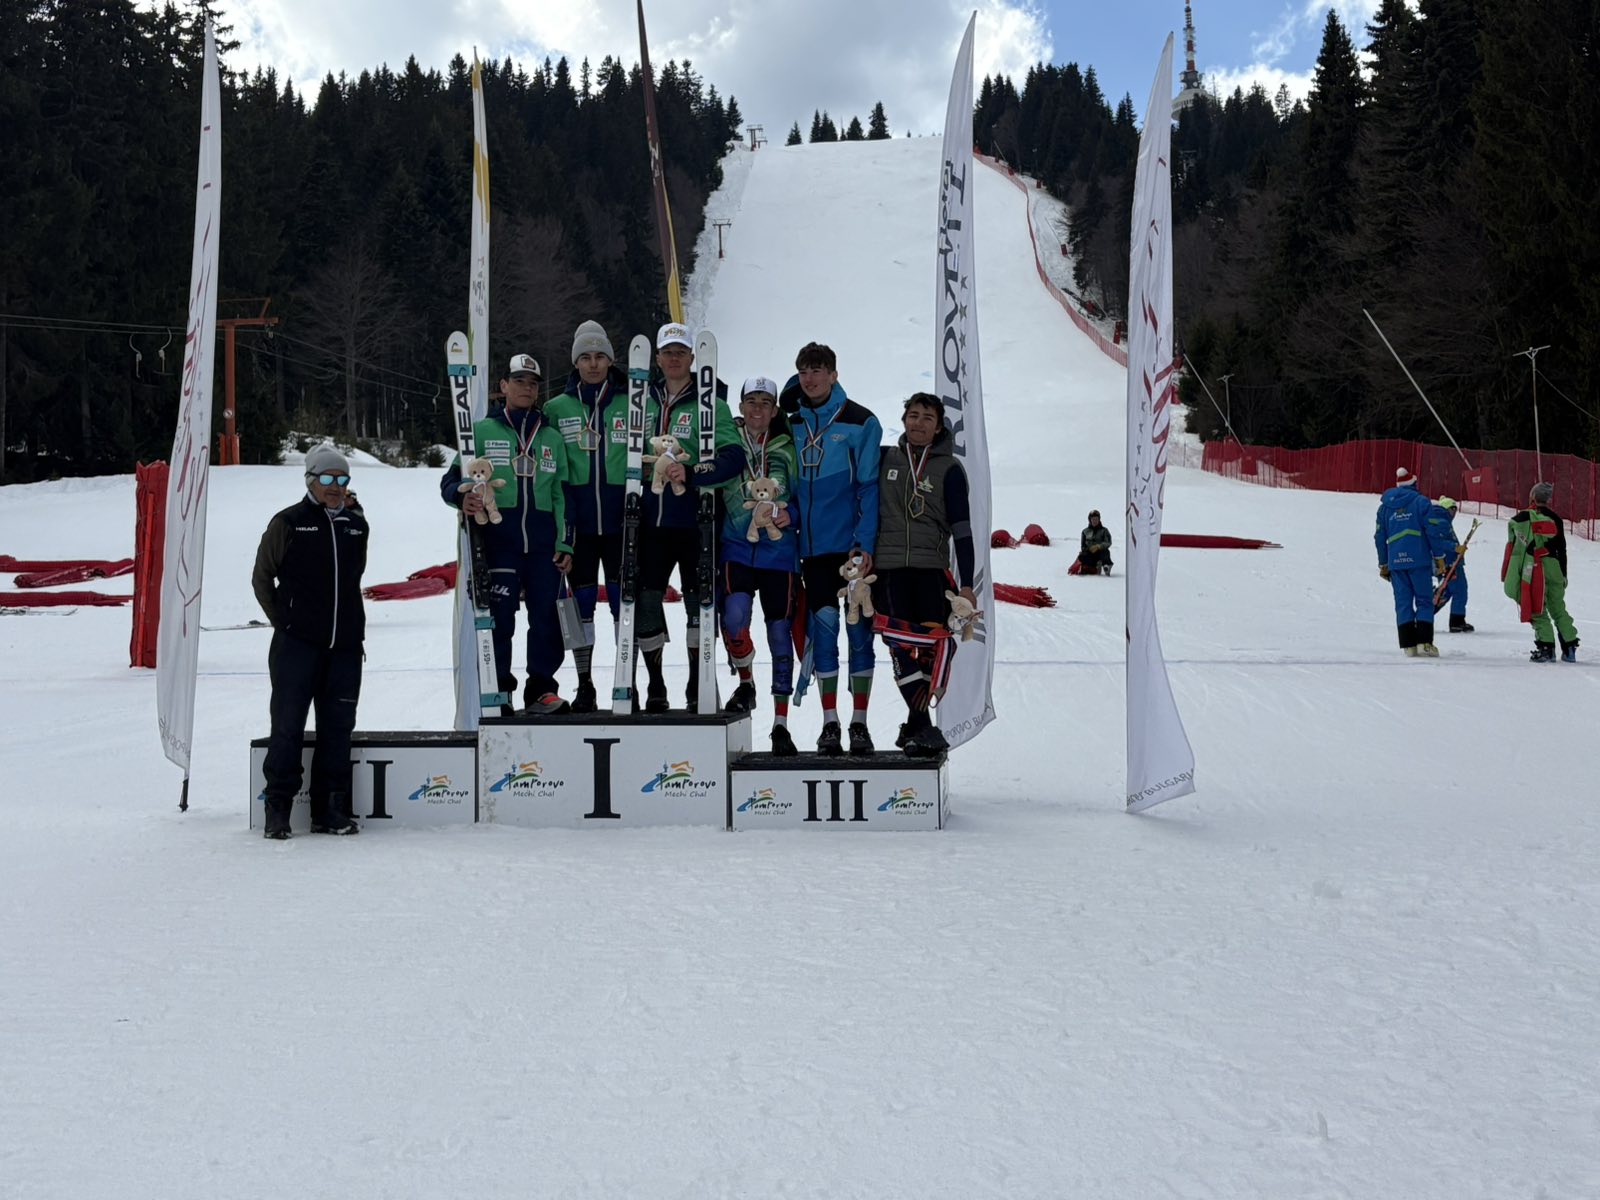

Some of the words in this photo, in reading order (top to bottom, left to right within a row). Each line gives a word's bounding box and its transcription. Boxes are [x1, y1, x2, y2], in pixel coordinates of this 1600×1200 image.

[700, 365, 714, 457] HEAD
[583, 737, 621, 819] I
[802, 780, 869, 822] III
